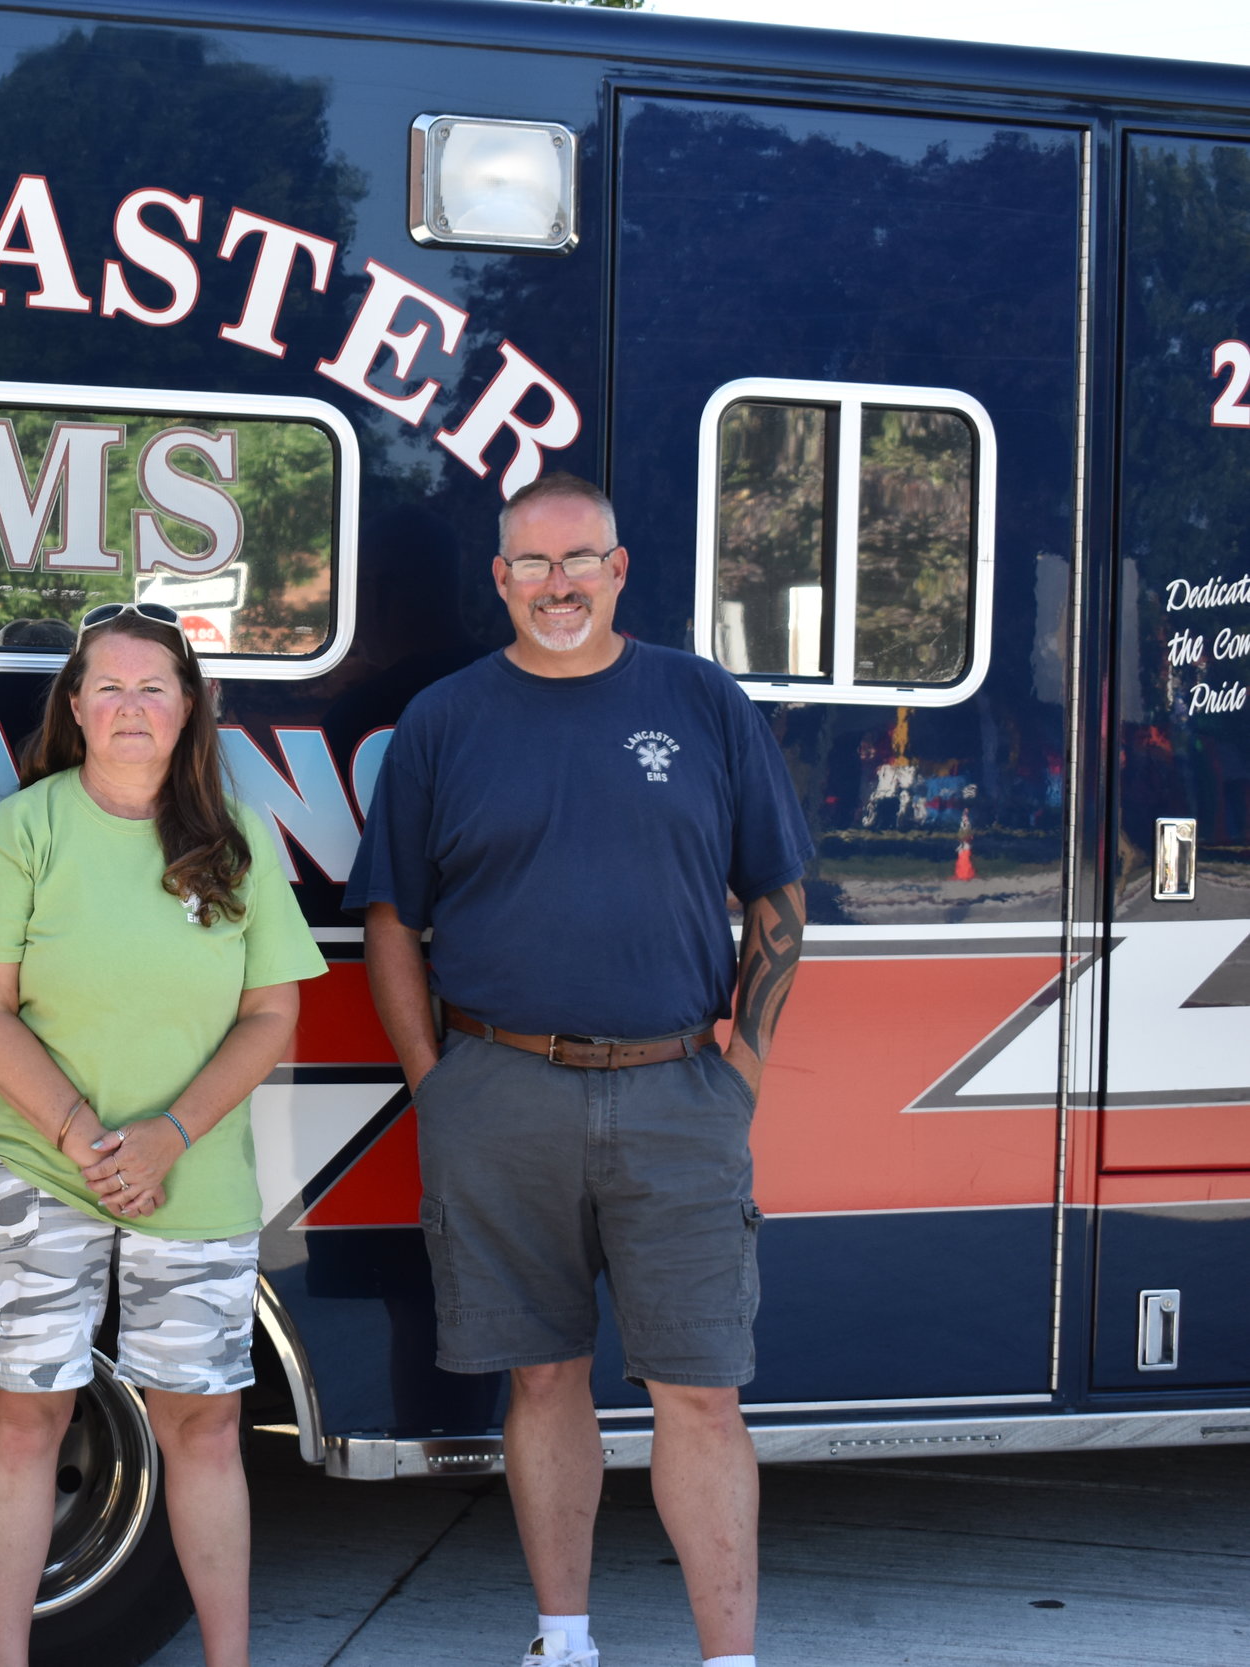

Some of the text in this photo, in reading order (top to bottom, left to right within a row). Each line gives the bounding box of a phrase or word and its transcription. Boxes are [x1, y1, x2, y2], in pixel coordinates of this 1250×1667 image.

[1167, 628, 1204, 667] the
[1188, 681, 1247, 716] Pride
[623, 730, 680, 753] LANCASTER
[646, 771, 668, 782] EMS
